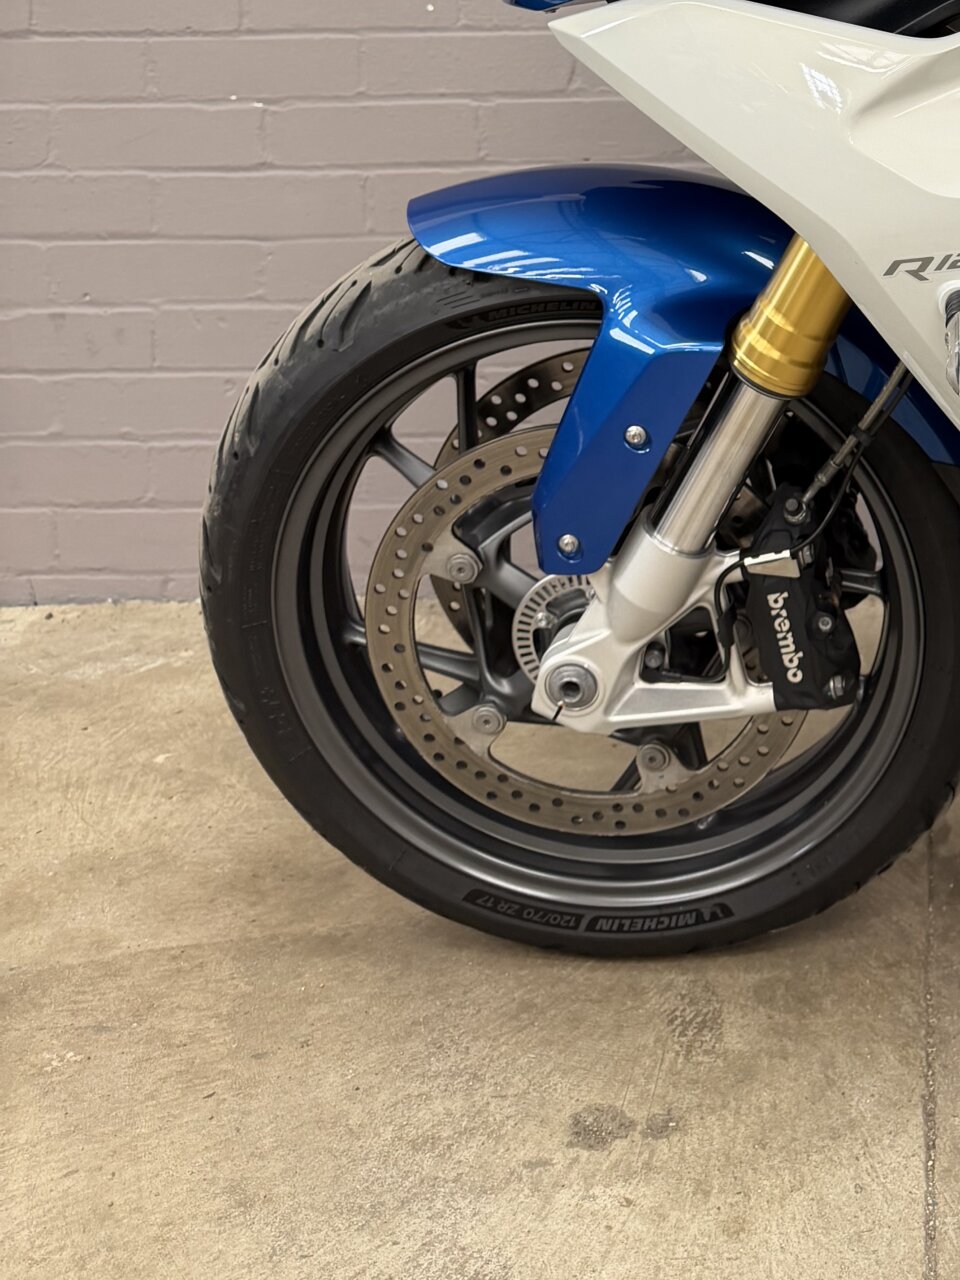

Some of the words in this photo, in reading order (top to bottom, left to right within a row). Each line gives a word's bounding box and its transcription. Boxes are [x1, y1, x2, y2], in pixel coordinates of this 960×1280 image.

[489, 302, 596, 321] MICHELIN
[766, 591, 804, 683] brembo
[476, 894, 495, 908] 17
[497, 901, 519, 917] ZR
[523, 909, 577, 928] 120/70
[597, 912, 696, 931] MICHELIN
